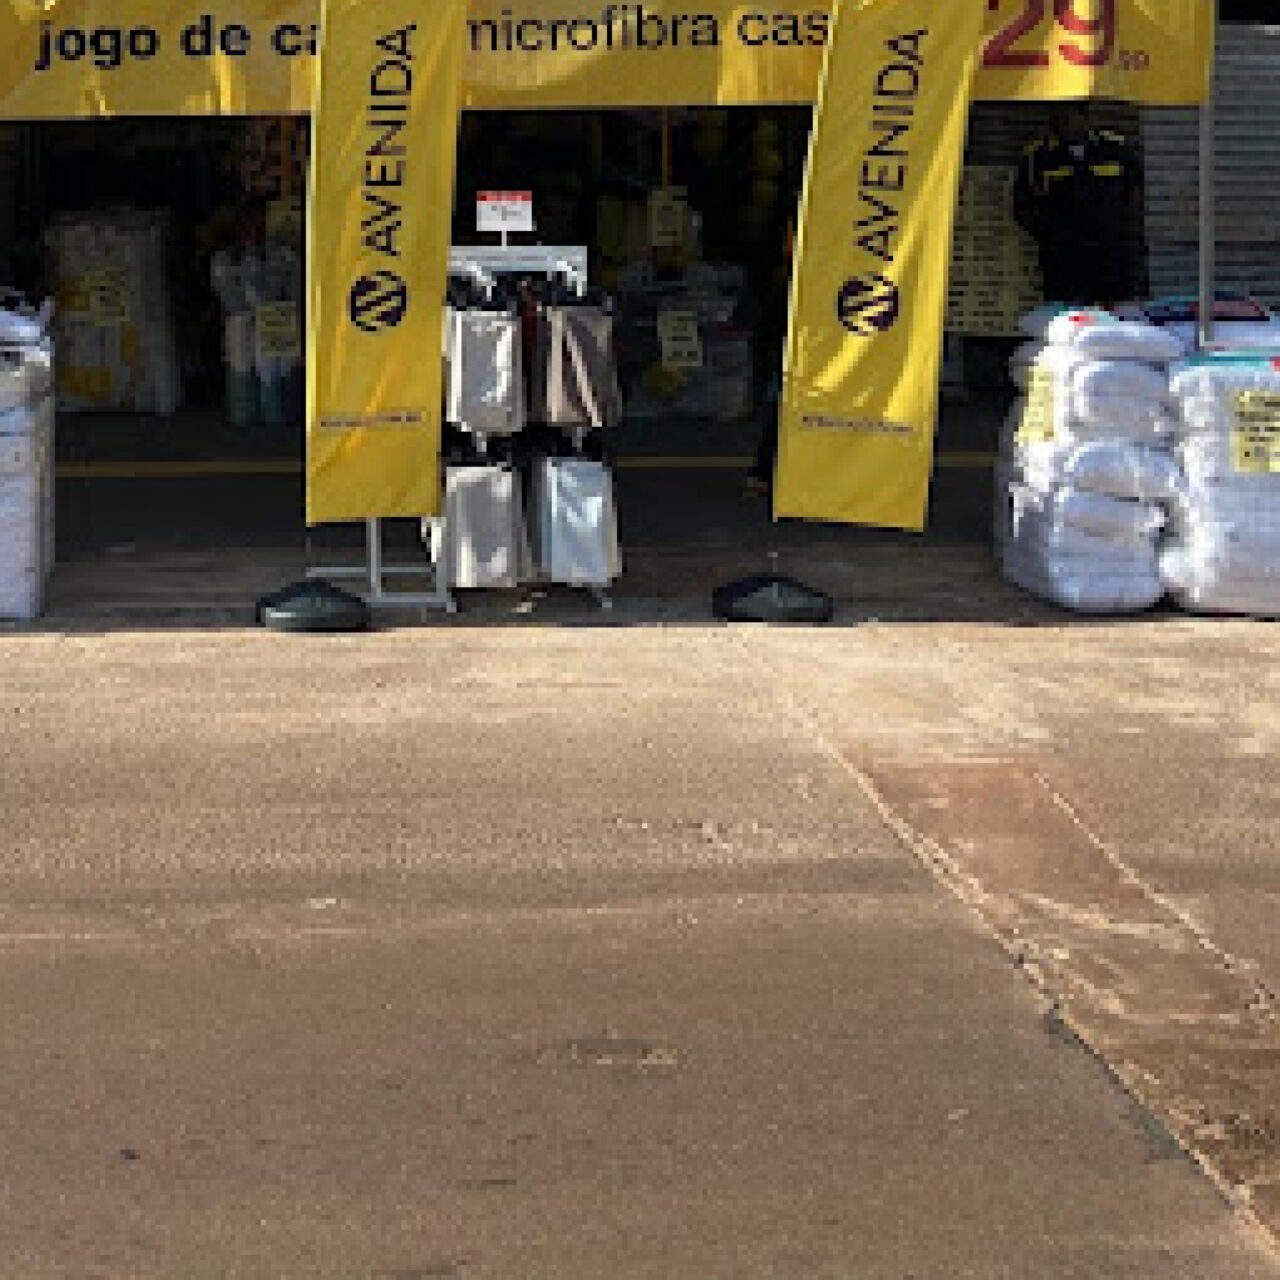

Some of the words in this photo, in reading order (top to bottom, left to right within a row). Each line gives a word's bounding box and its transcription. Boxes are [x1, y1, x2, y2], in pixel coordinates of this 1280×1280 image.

[35, 20, 160, 71] jogo
[180, 15, 252, 56] de
[467, 4, 720, 52] microfibra
[359, 23, 417, 257] AVENIDA
[856, 27, 928, 262] AVENIDA
